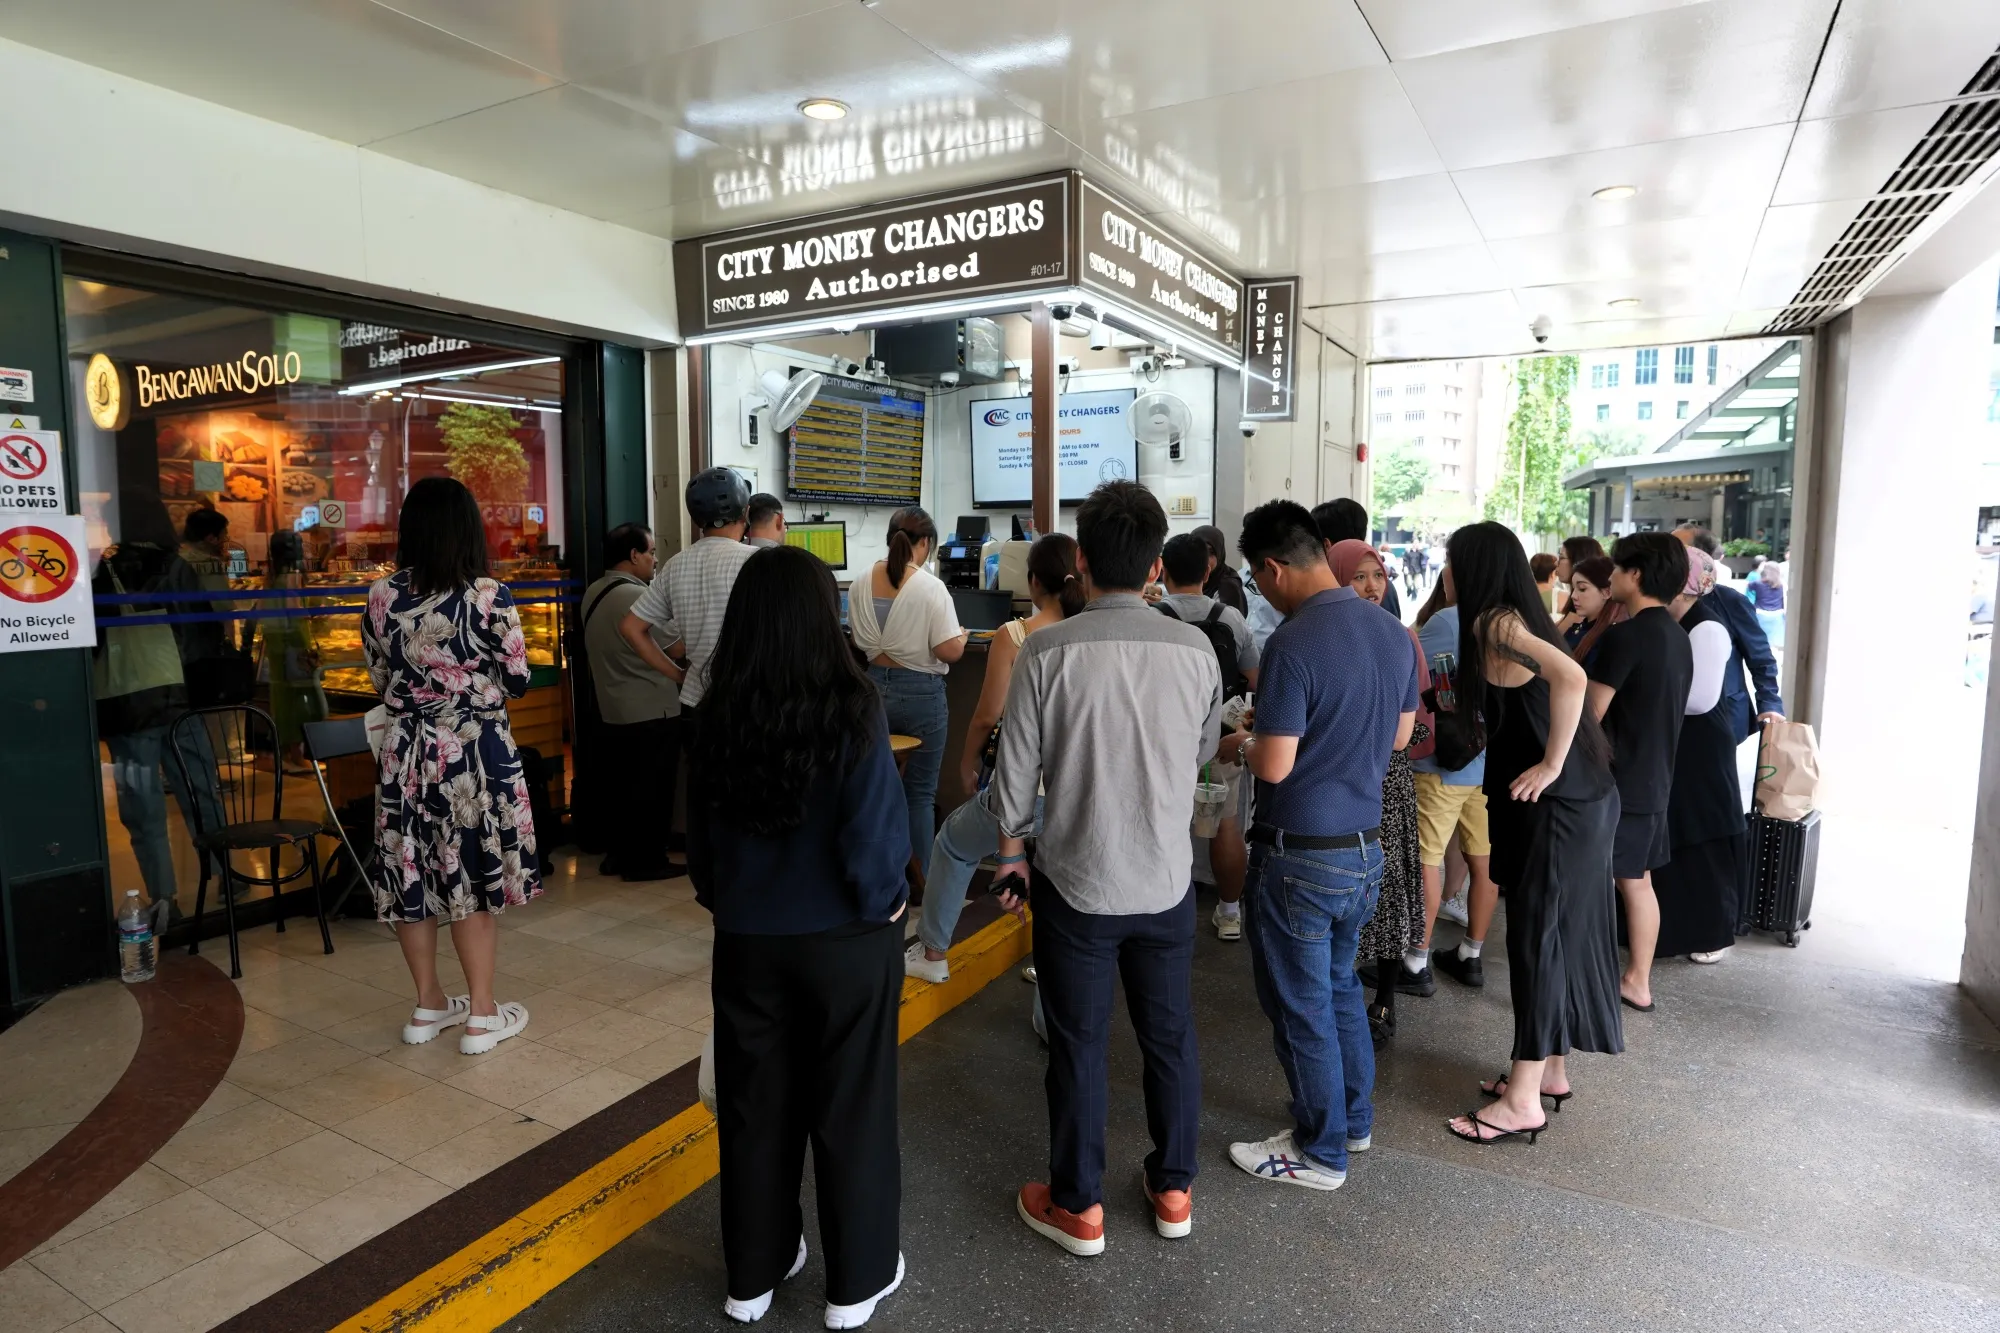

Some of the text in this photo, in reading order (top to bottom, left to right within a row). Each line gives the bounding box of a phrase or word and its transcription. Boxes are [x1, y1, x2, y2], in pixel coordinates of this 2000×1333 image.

[717, 200, 1044, 282] CITY MONEY CHANGERS
[1030, 262, 1062, 277] #01-17
[1102, 211, 1238, 313] CITY MONEY CHANGERS
[712, 252, 980, 314] SINCE 1980 Authorised
[1088, 252, 1117, 280] SINCE
[1150, 278, 1218, 332] Authorised
[1255, 289, 1268, 355] MONEY
[1271, 313, 1284, 406] CHANGER
[827, 377, 842, 387] CITY
[841, 380, 864, 392] MONEY
[864, 384, 897, 398] CHANGERS
[1071, 406, 1120, 417] CHANGERS
[0, 484, 56, 496] O PETS
[0, 497, 58, 508] LLOWED
[0, 614, 75, 628] No Bicycle
[10, 629, 70, 644] Allowed
